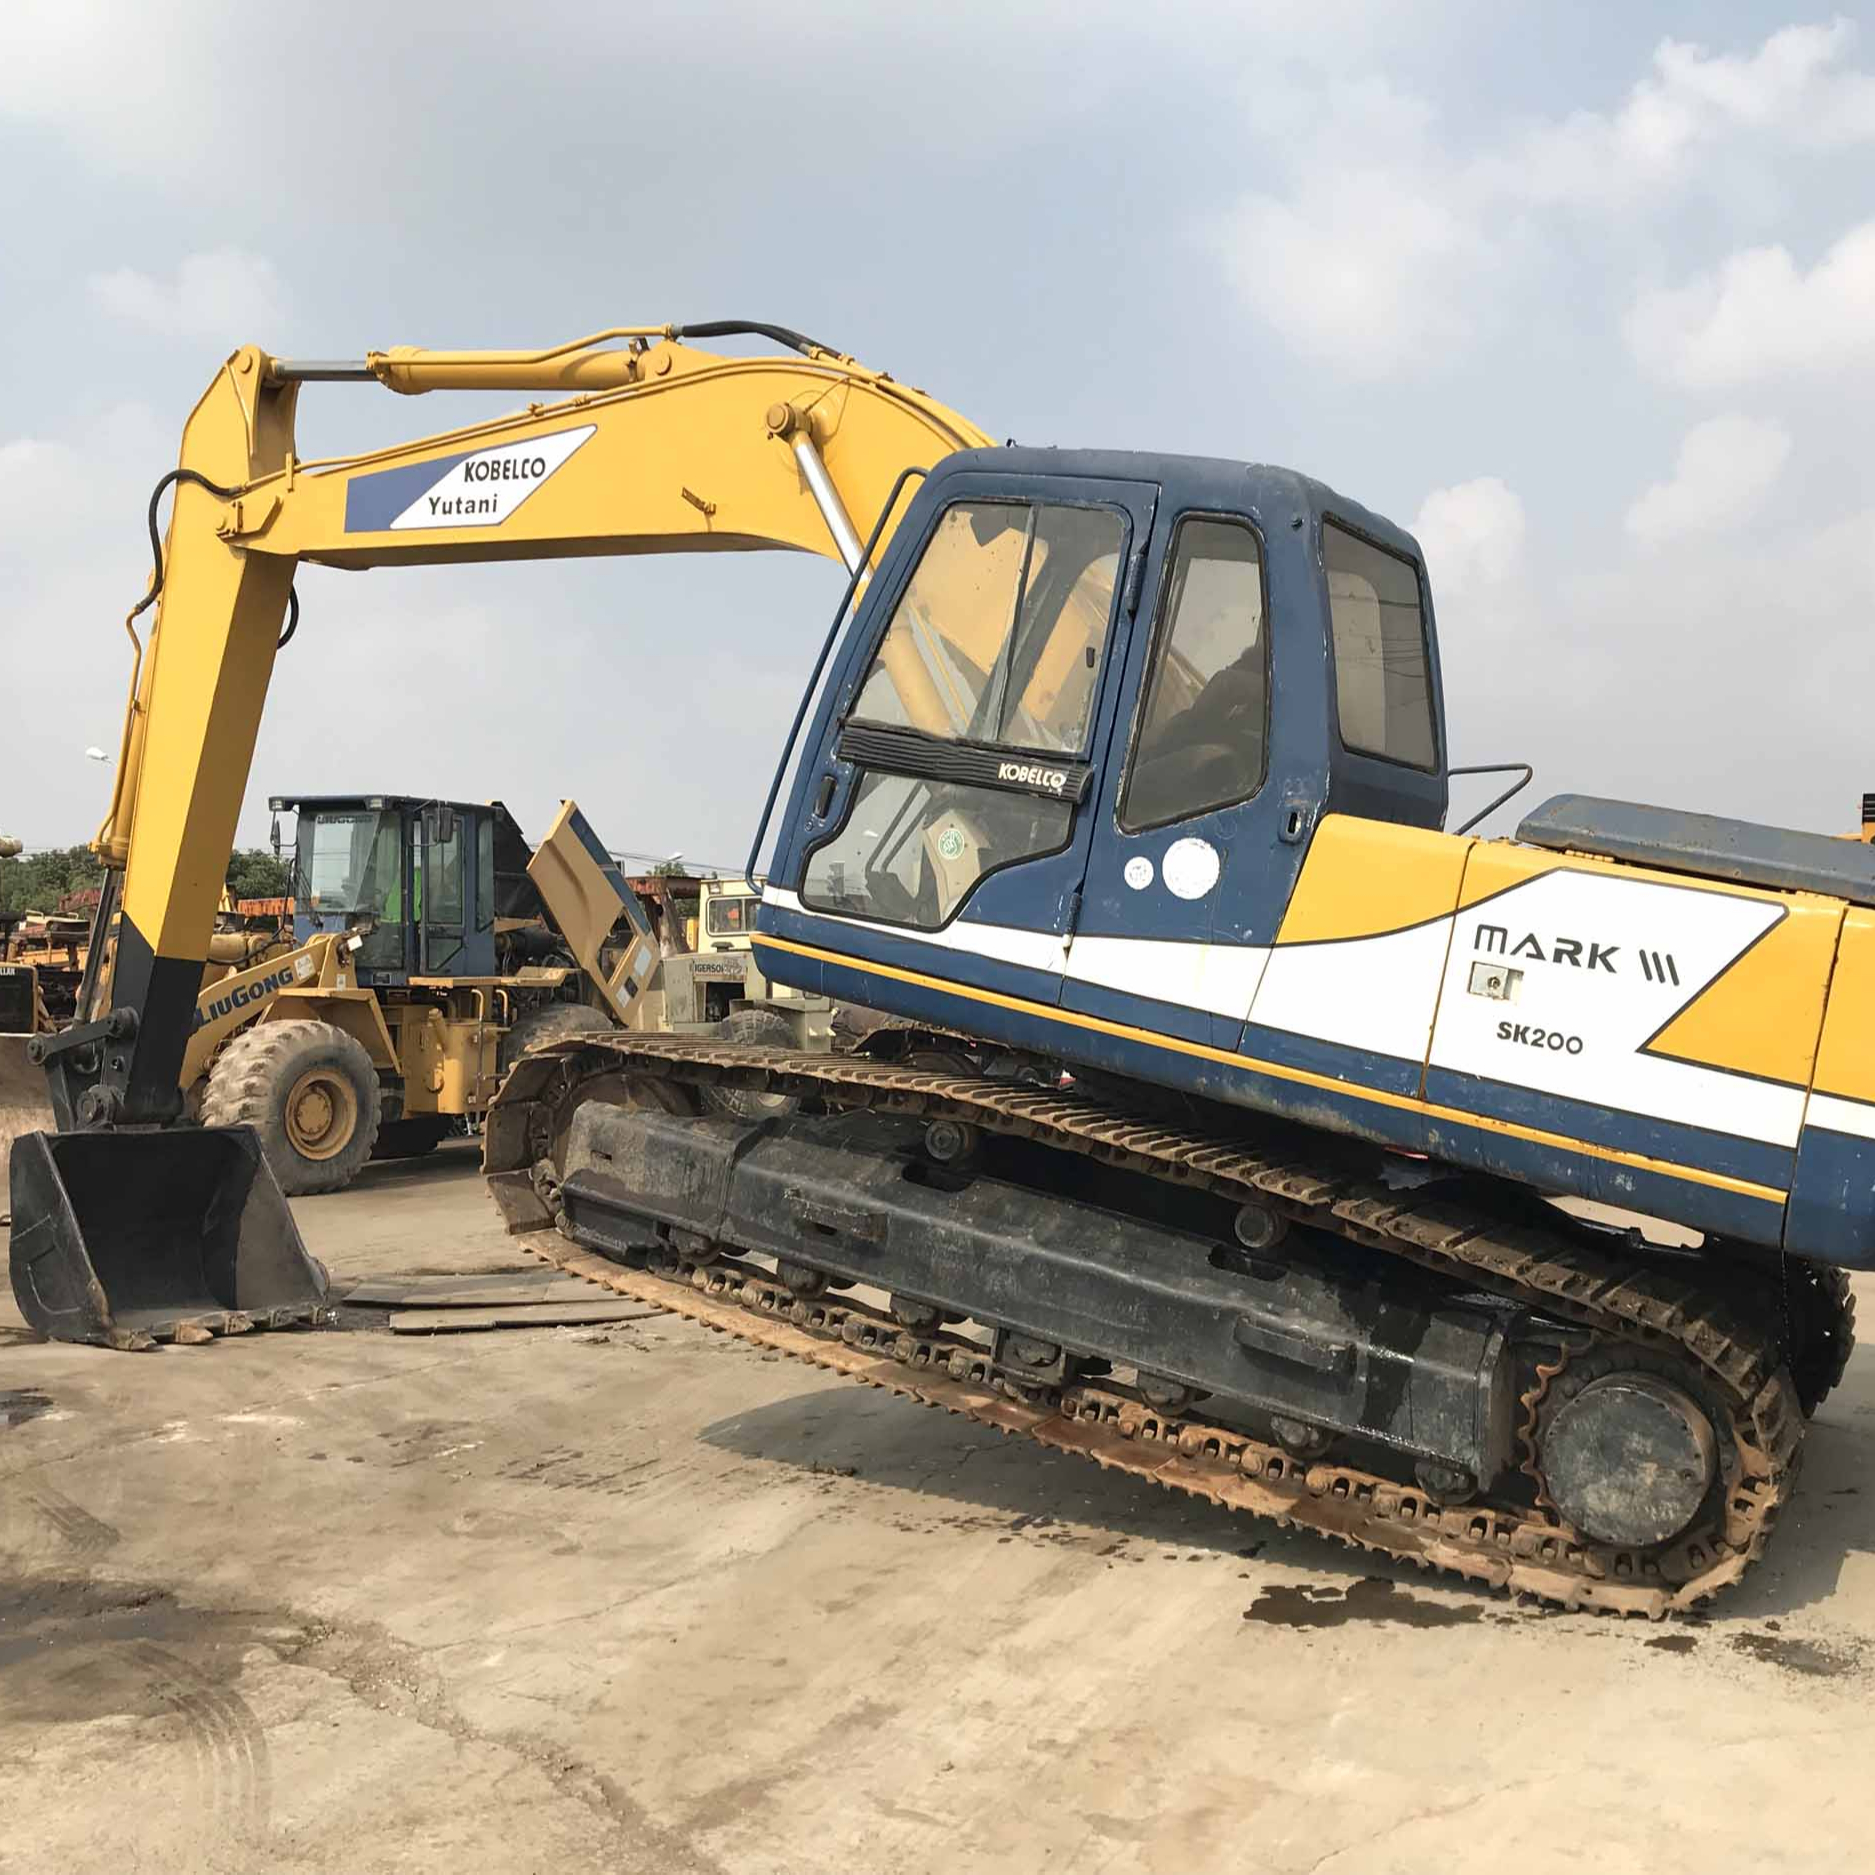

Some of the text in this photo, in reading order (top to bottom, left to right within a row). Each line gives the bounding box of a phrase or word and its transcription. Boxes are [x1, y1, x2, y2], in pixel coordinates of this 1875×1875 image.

[464, 457, 546, 483] KOBELCO
[428, 493, 498, 516] Yutani
[998, 762, 1067, 789] KOBELCO
[1473, 923, 1621, 974] MARK
[1496, 1020, 1584, 1055] SK200
